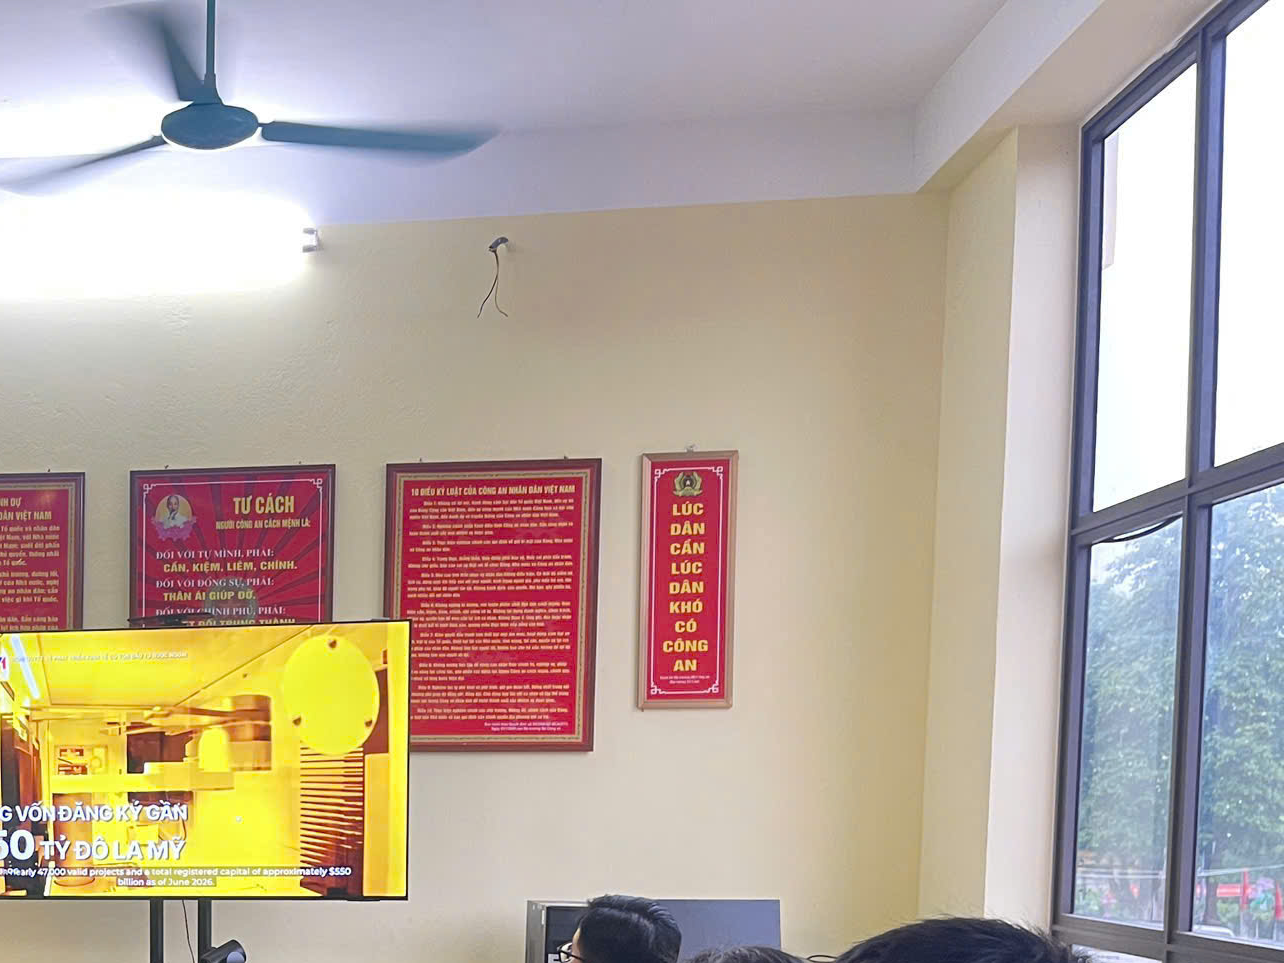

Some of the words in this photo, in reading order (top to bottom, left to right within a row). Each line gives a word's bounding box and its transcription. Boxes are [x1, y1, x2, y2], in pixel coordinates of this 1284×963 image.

[411, 488, 419, 497] 10
[498, 486, 507, 495] AN
[559, 485, 576, 494] NAM
[233, 496, 253, 515] TƯ
[255, 493, 294, 514] CÁCH
[672, 501, 704, 516] LÚC
[15, 509, 32, 523] VIỆT
[34, 510, 52, 520] NAM
[215, 520, 235, 530] NGƯỜI
[236, 519, 253, 529] CÔNG
[254, 520, 263, 529] AN
[264, 518, 281, 528] CÁCH
[282, 518, 300, 529] MỆNH
[670, 520, 705, 536] DÂN
[156, 549, 174, 560] ĐỐI
[177, 549, 196, 560] VỚI
[198, 549, 212, 561] TỰ
[214, 548, 244, 559] MÌNH,
[246, 547, 274, 558] PHẢI:
[669, 539, 705, 556] CẦN
[163, 561, 189, 574] CẦN,
[260, 559, 298, 571] CHÍNH.
[671, 559, 703, 575] LÚC
[156, 578, 174, 589] ĐỐI
[177, 578, 196, 589] VỚI
[246, 576, 274, 587] PHẢI:
[669, 579, 704, 594] DÂN
[163, 589, 192, 602] THÂN
[195, 589, 206, 601] ÁI
[209, 588, 235, 601] GIÚP
[258, 605, 286, 615] PHẢI:
[669, 599, 703, 614] KHÓ
[674, 618, 697, 633] CÓ
[662, 638, 709, 653] CÔNG
[673, 659, 697, 672] AN
[15, 801, 55, 822] VỐN
[56, 801, 114, 822] ĐĂNG
[116, 800, 142, 821] KÝ
[145, 799, 189, 822] GẦN
[39, 834, 70, 861] TỶ
[73, 838, 113, 860] ĐÔ
[114, 840, 144, 860] LA
[147, 835, 187, 860] MỸ
[67, 866, 88, 877] valid
[89, 866, 125, 878] projects
[125, 866, 143, 877] and
[152, 867, 171, 877] total
[173, 866, 218, 878] registered
[220, 866, 250, 878] capital
[252, 866, 261, 876] of
[263, 866, 328, 878] approximately
[329, 866, 352, 877] $550
[117, 877, 145, 887] billion
[146, 879, 156, 887] as
[157, 877, 166, 886] of
[168, 877, 190, 887] June
[191, 877, 214, 887] 2026.
